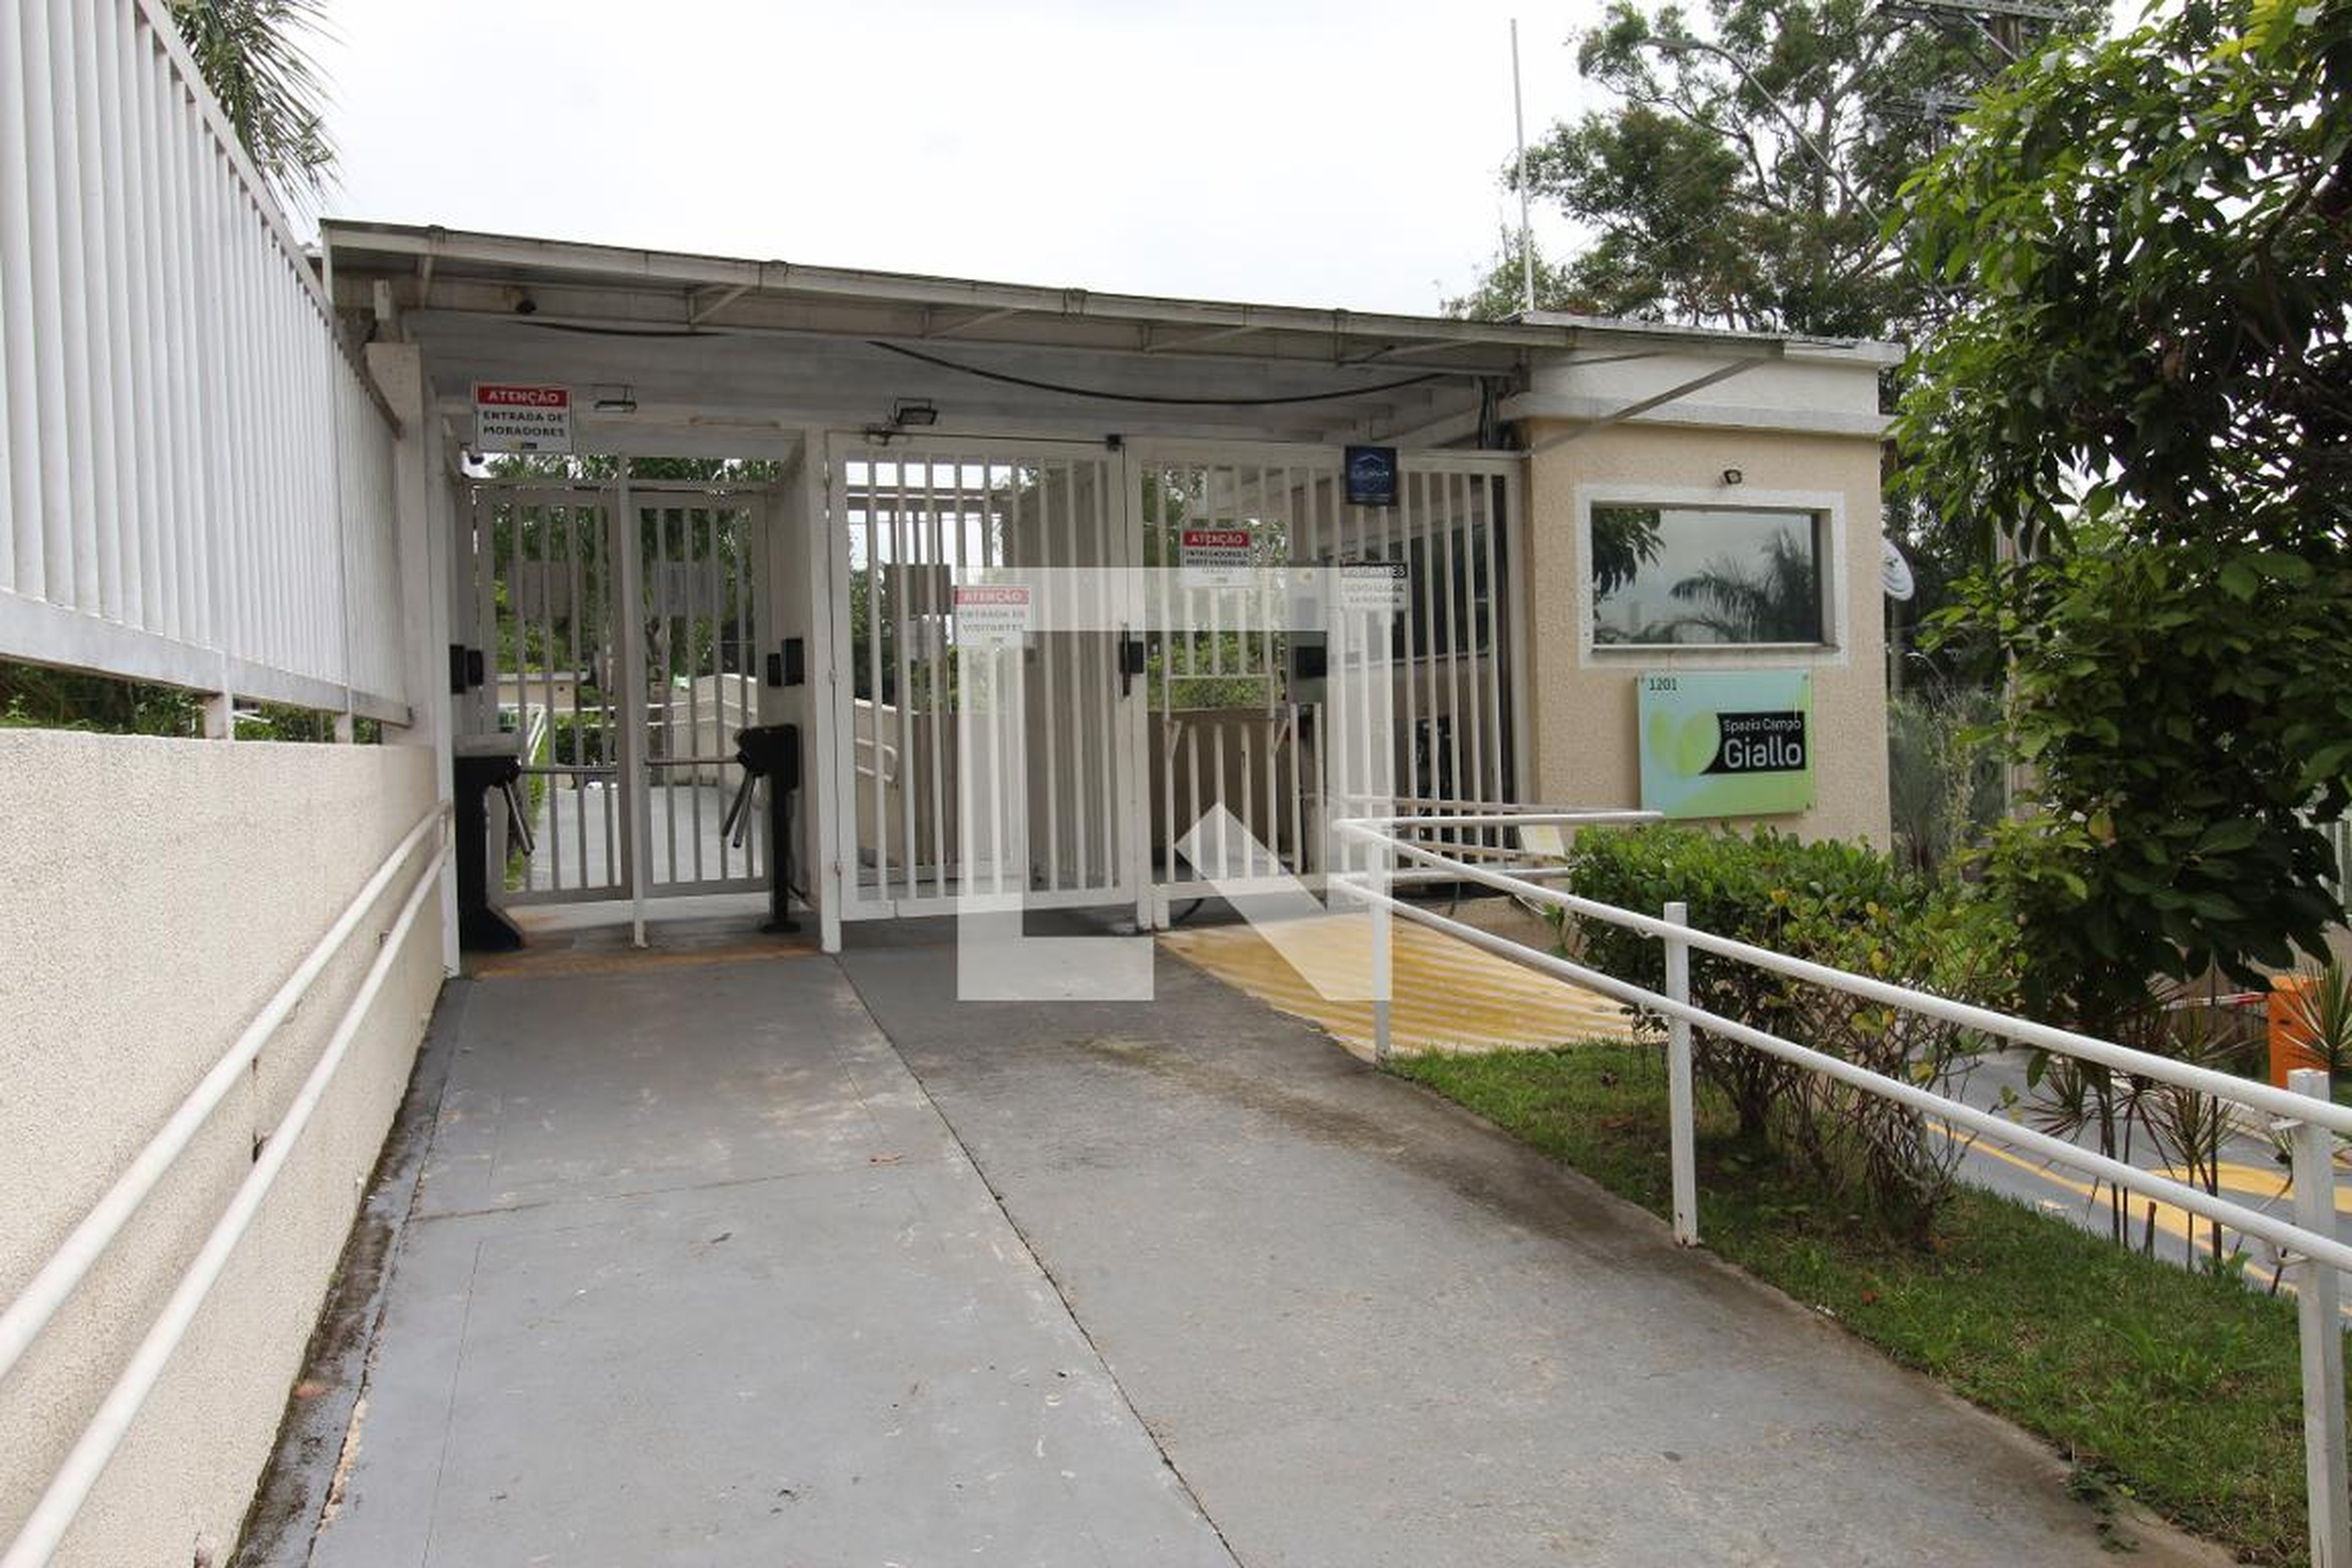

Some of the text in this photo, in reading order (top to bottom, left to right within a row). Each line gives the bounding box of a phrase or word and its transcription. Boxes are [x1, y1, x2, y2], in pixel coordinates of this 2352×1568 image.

[488, 389, 559, 404] ATENÇÃO
[483, 411, 564, 423] ENTRADA DE
[483, 426, 565, 437] MORADORES
[1191, 533, 1242, 545] ATENÇÃO
[963, 589, 1023, 603] ATENÇÃO
[1649, 678, 1677, 691] 1201
[1724, 718, 1801, 734] Spazio Campo
[1725, 736, 1802, 767] Giallo
